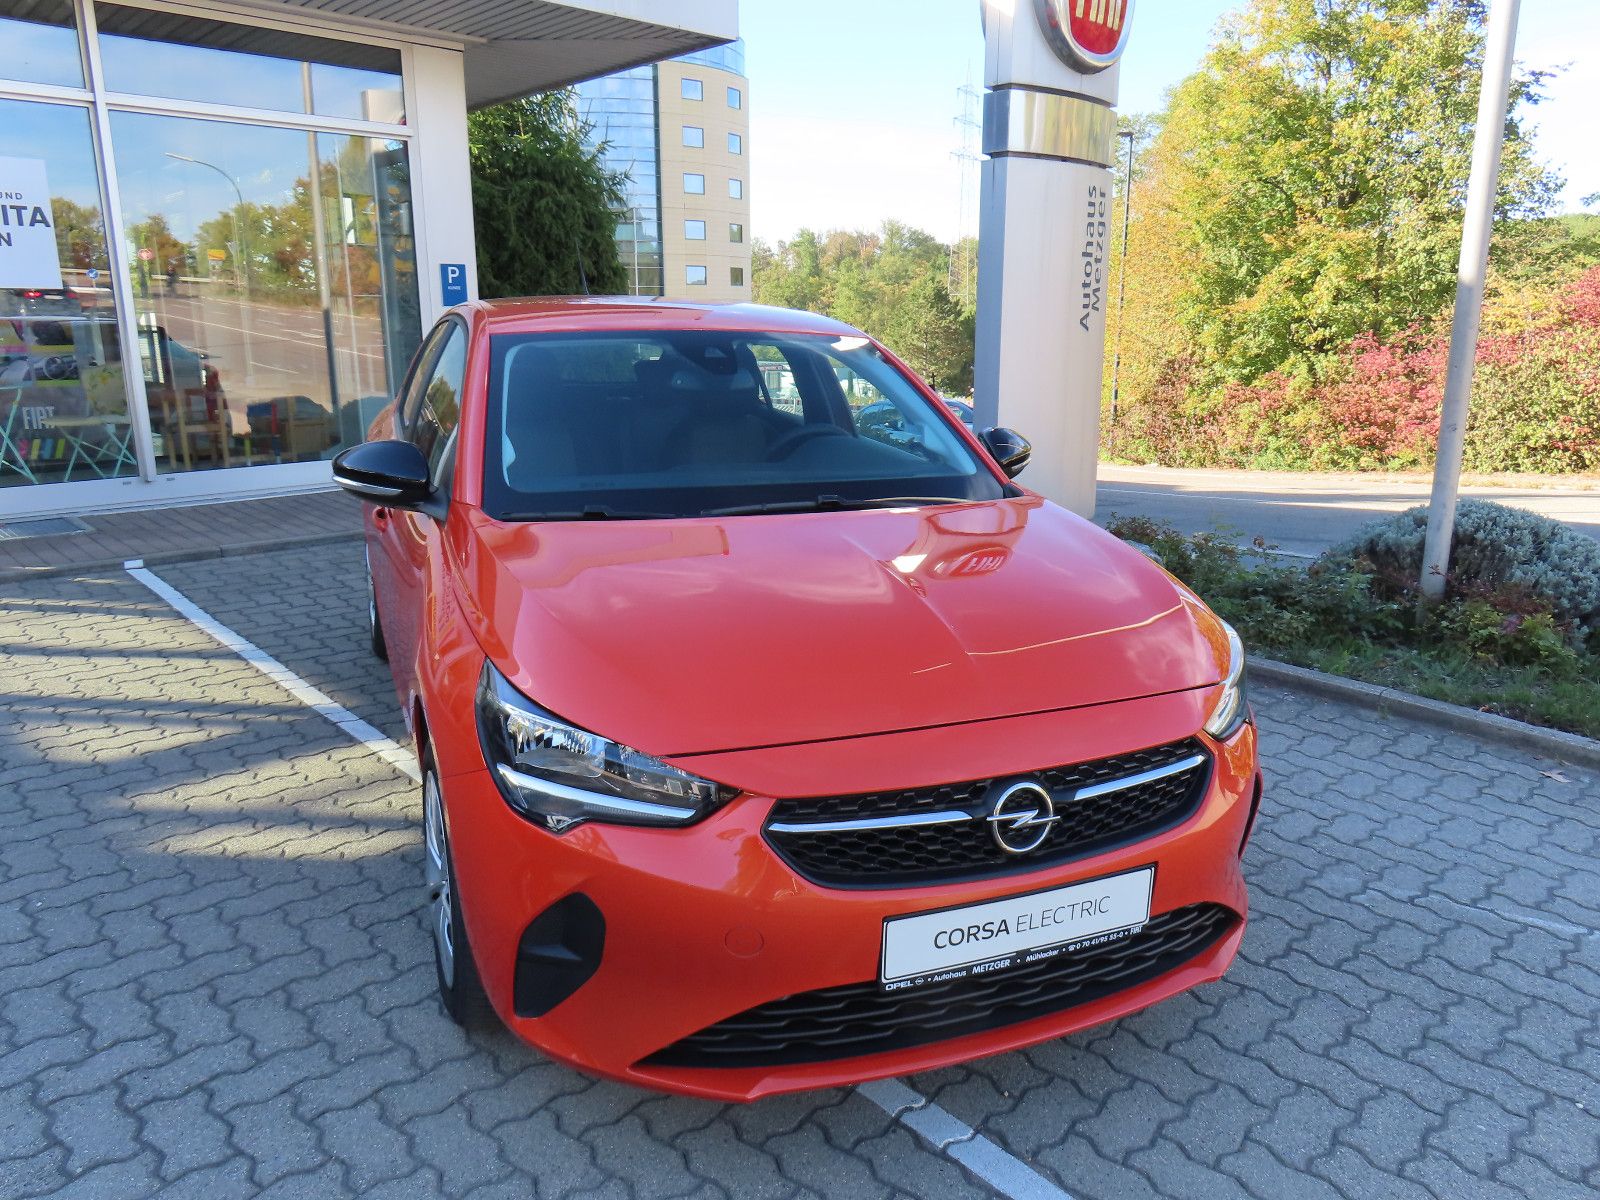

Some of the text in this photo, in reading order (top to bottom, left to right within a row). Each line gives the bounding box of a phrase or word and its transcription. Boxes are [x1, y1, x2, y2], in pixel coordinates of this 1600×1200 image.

[447, 266, 460, 284] P
[1079, 185, 1097, 331] Autohaus
[1091, 187, 1107, 312] Metzger
[933, 895, 1111, 949] CORSA ELECTRIC
[885, 979, 914, 991] OPEL
[933, 970, 967, 982] Autohaus
[972, 958, 1011, 975] METZGER
[1025, 949, 1059, 963] Mühlacker
[1129, 925, 1143, 936] FIAT
